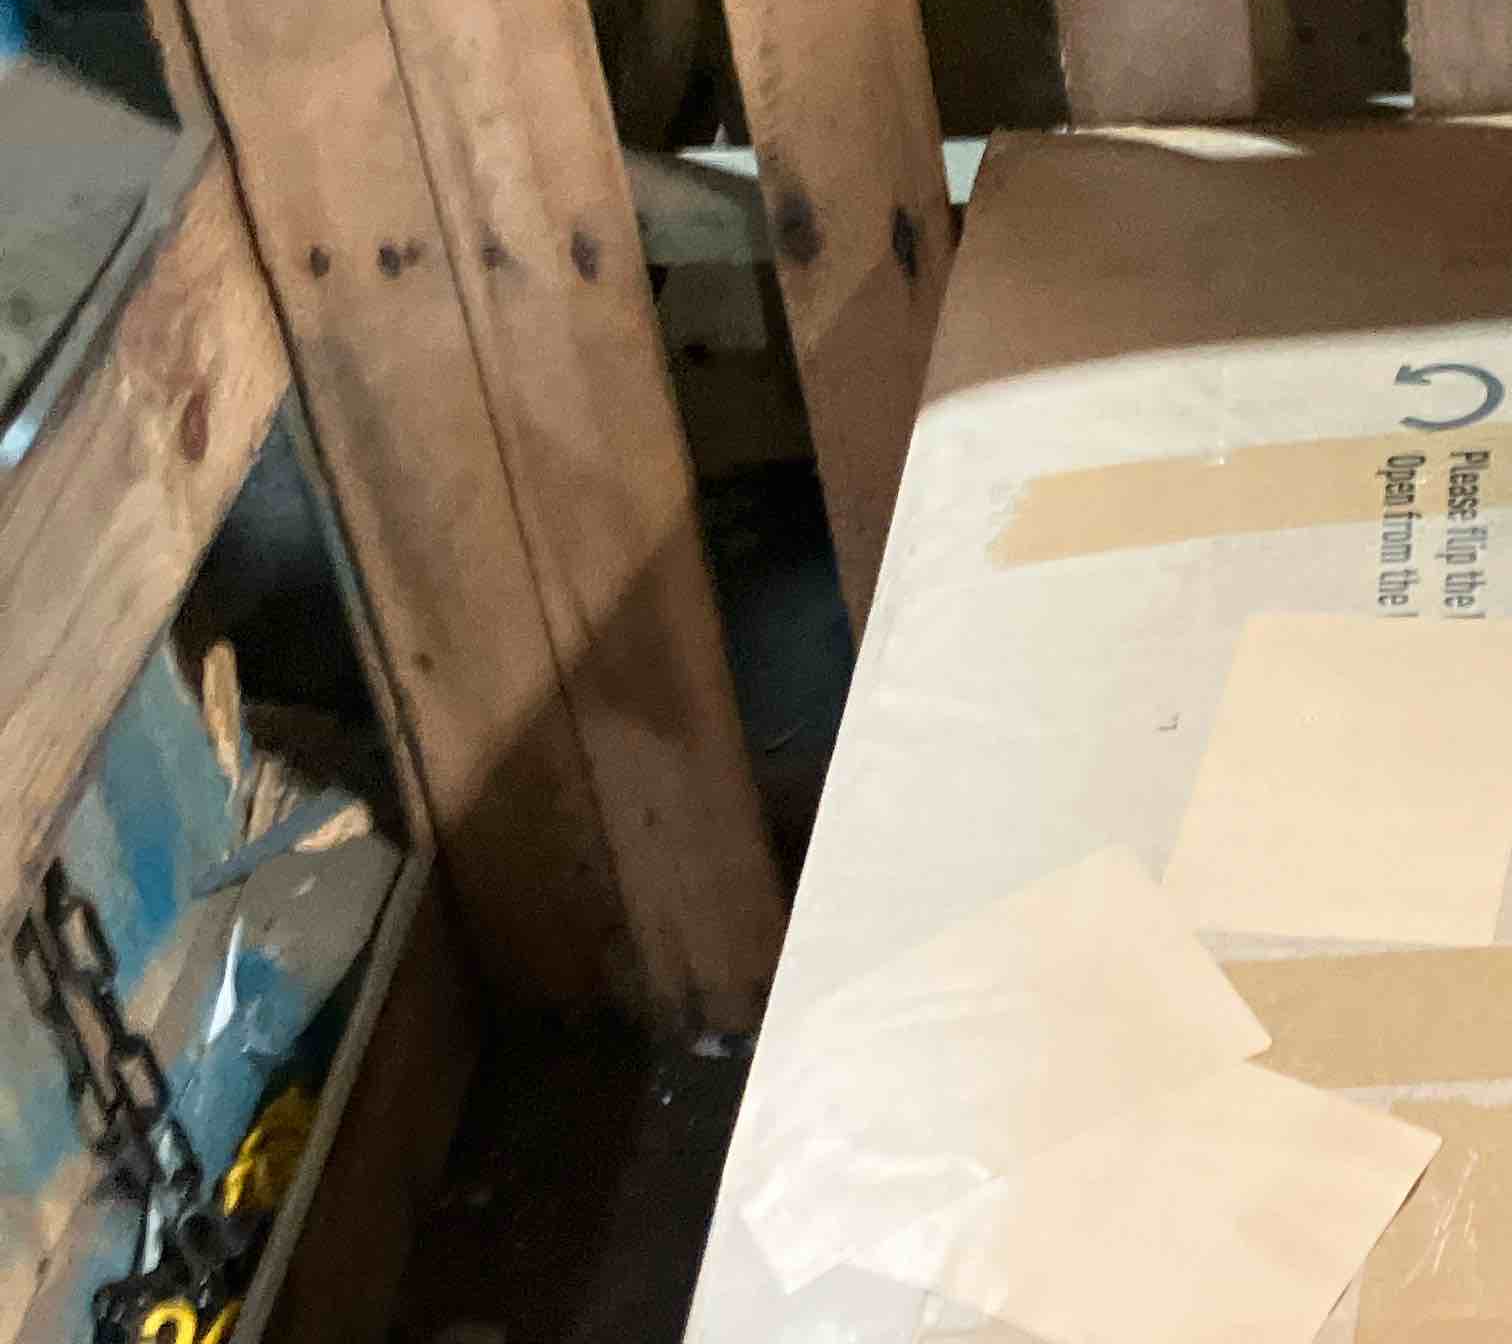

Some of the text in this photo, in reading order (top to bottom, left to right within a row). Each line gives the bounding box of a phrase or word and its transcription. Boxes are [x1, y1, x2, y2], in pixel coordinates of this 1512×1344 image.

[1375, 455, 1426, 506] Open
[1449, 451, 1491, 520] Please
[1381, 512, 1422, 564] from
[1435, 527, 1488, 564] flip
[1378, 569, 1418, 605] the
[1445, 571, 1487, 607] the
